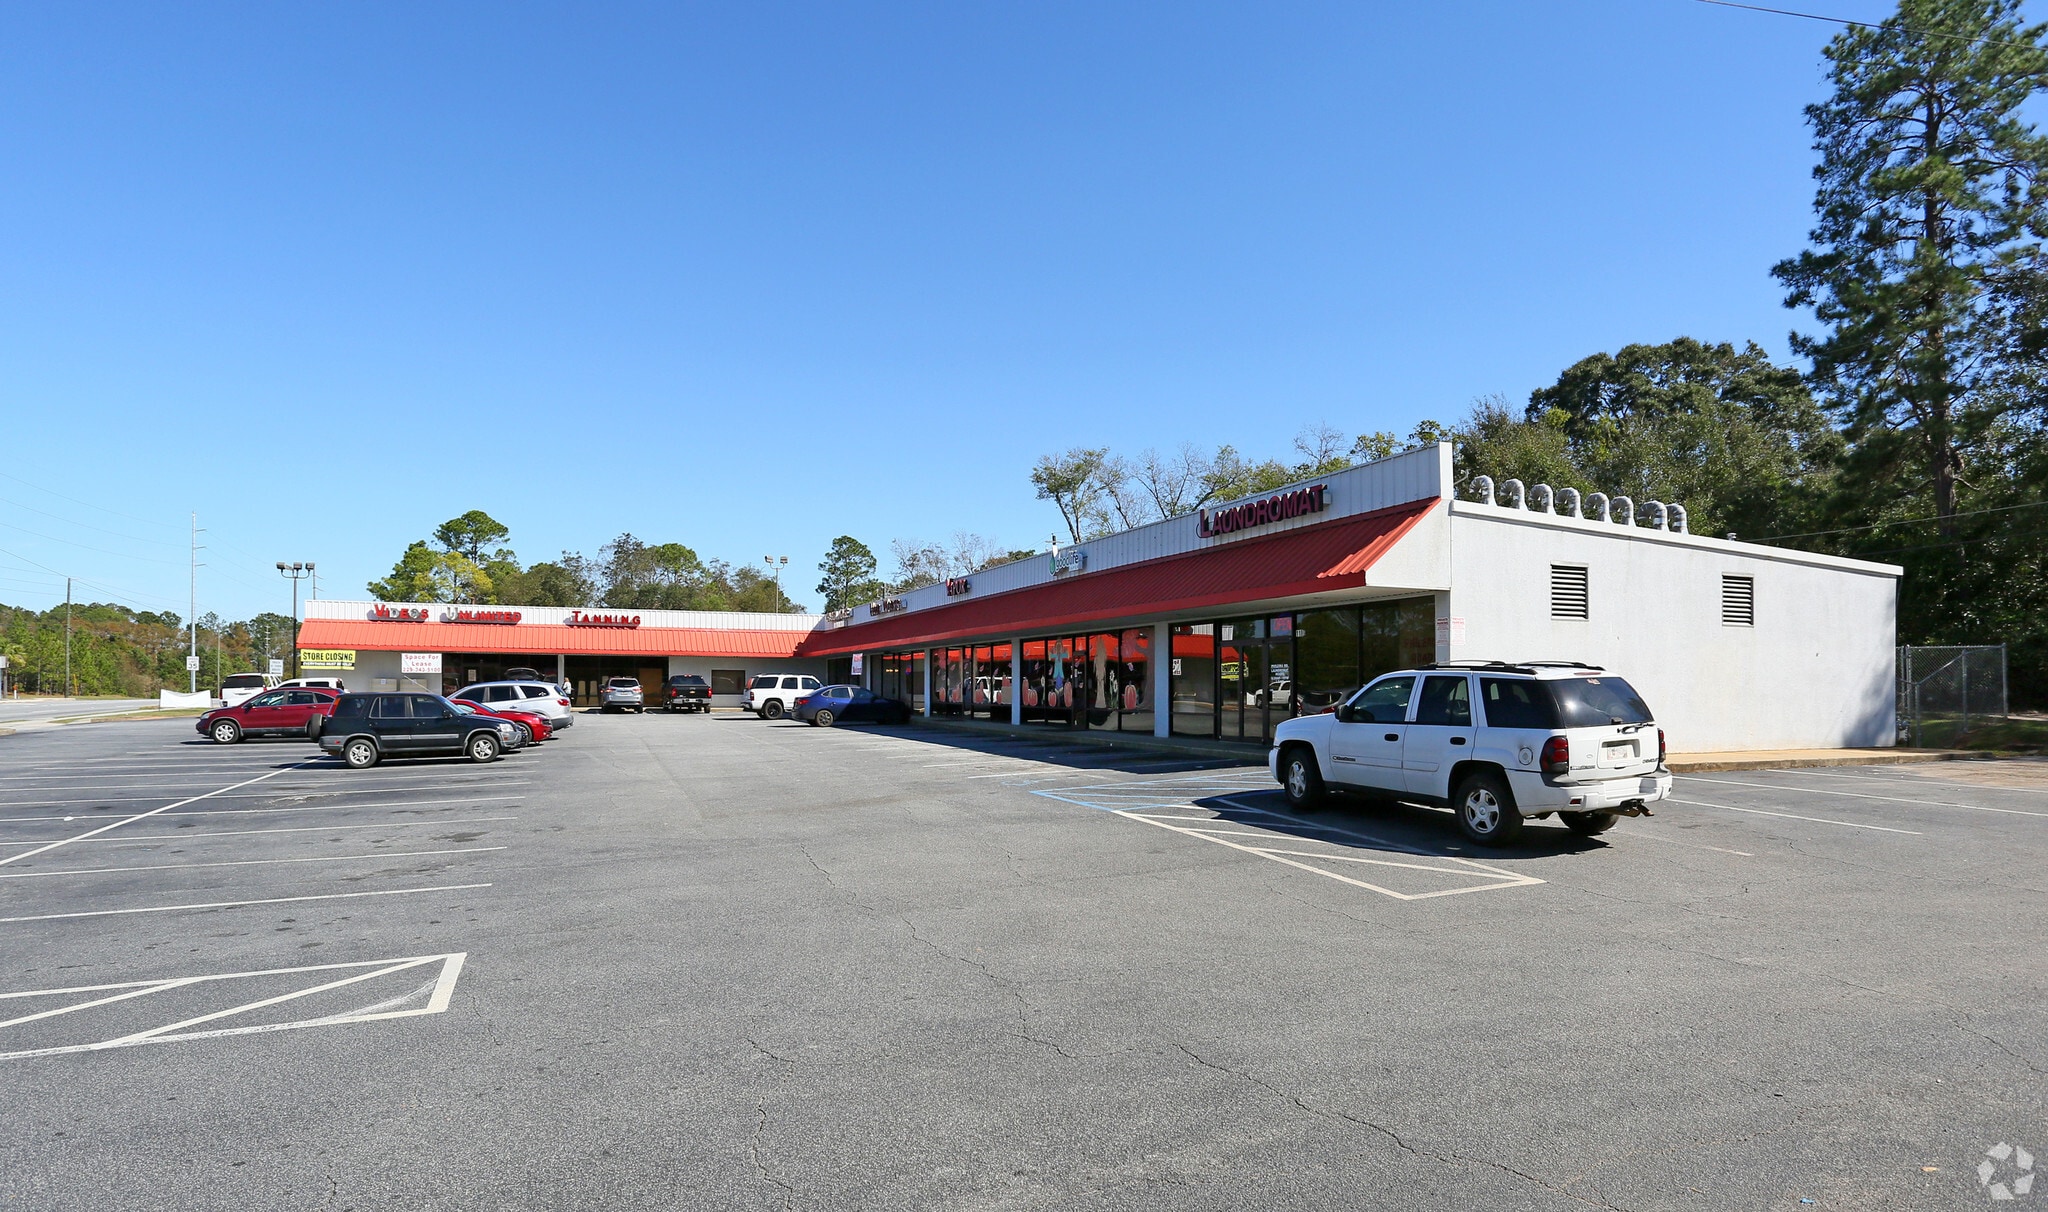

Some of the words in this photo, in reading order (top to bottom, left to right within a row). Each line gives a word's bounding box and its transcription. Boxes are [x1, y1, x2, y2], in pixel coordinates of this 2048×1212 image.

[1200, 483, 1328, 538] LAUNDROMAT
[374, 603, 429, 619] VIDEOS
[446, 606, 522, 622] UNLIMITED
[571, 610, 641, 625] TANNING
[302, 652, 324, 661] STORE
[325, 652, 353, 662] CLOSING
